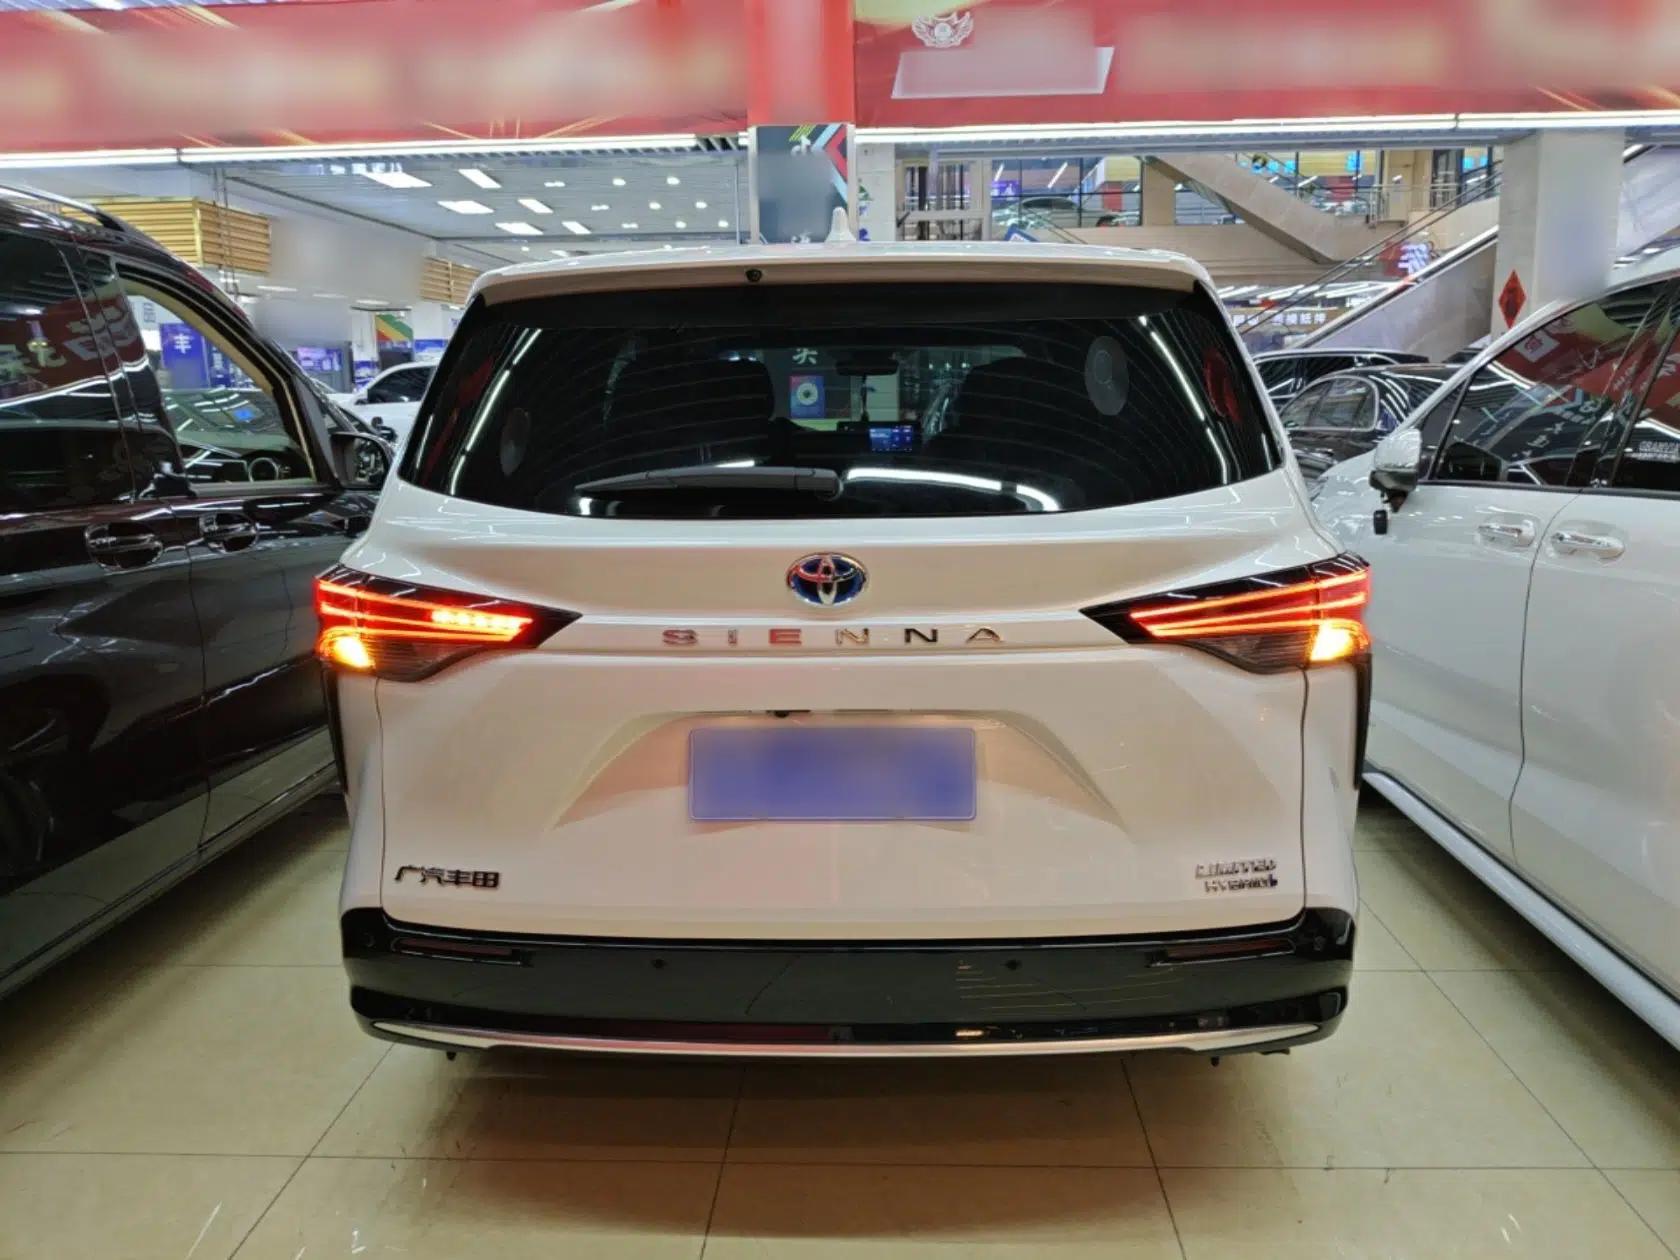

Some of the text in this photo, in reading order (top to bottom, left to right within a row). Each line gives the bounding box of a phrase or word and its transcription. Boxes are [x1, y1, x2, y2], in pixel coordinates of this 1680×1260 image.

[661, 627, 1002, 645] SIENNA
[394, 865, 500, 888] 广汽丰田
